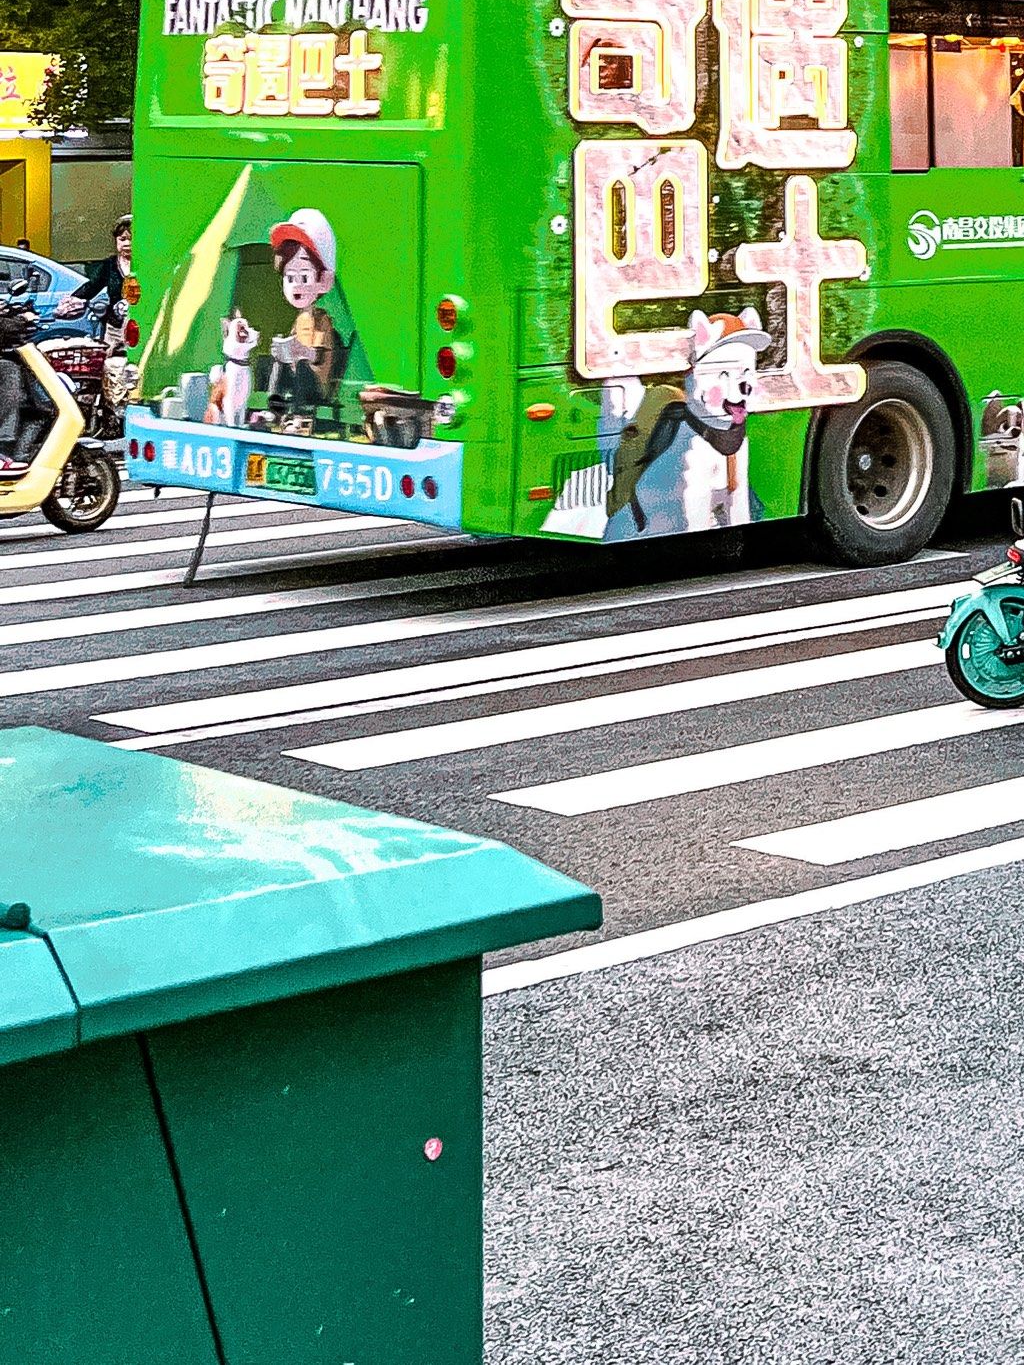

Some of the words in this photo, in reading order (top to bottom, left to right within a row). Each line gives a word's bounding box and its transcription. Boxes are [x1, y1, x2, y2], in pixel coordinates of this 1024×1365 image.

[203, 29, 383, 117] 奇遇巴士
[572, 138, 867, 412] 巴士
